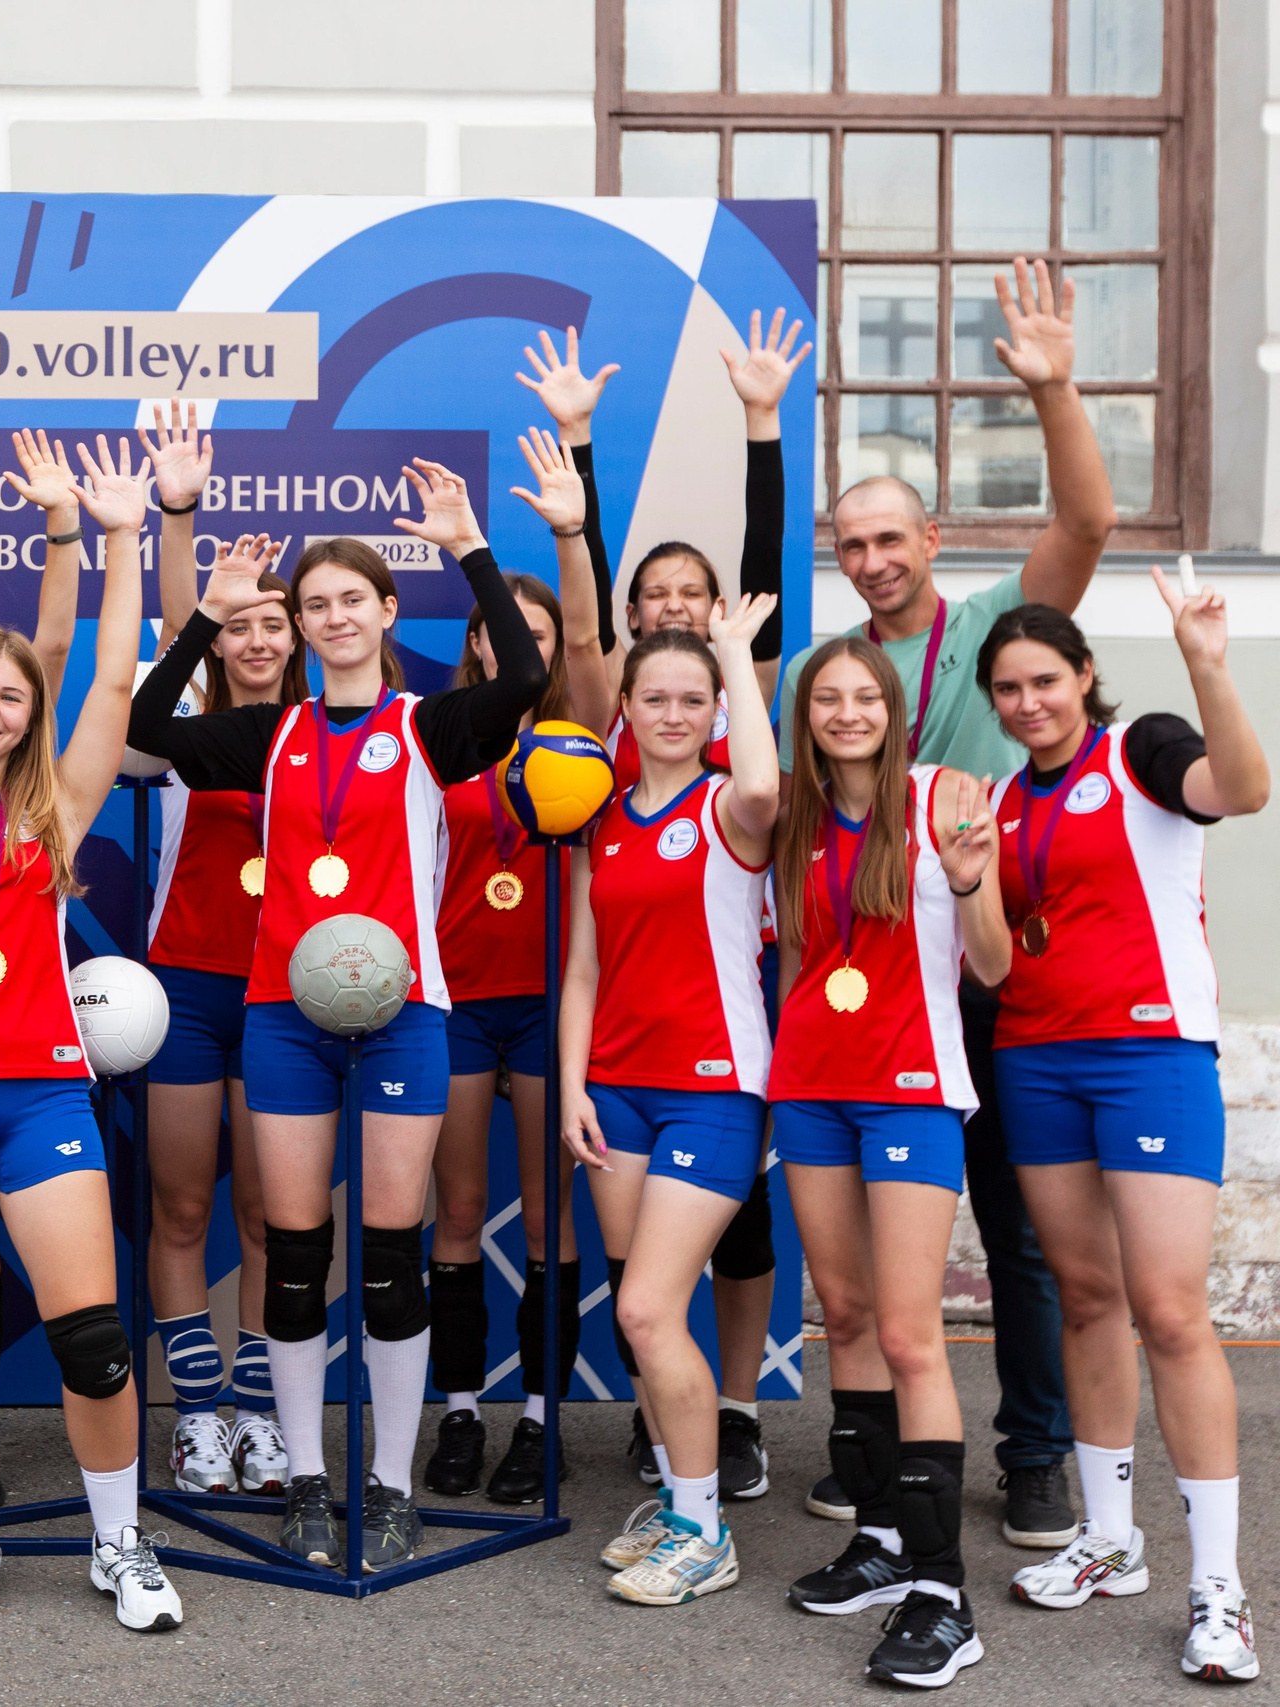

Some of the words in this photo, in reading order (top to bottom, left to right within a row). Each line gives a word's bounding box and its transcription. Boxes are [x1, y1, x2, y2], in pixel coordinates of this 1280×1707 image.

[376, 542, 429, 564] 2023
[565, 738, 603, 753] MIKASA
[73, 994, 110, 1007] KASA
